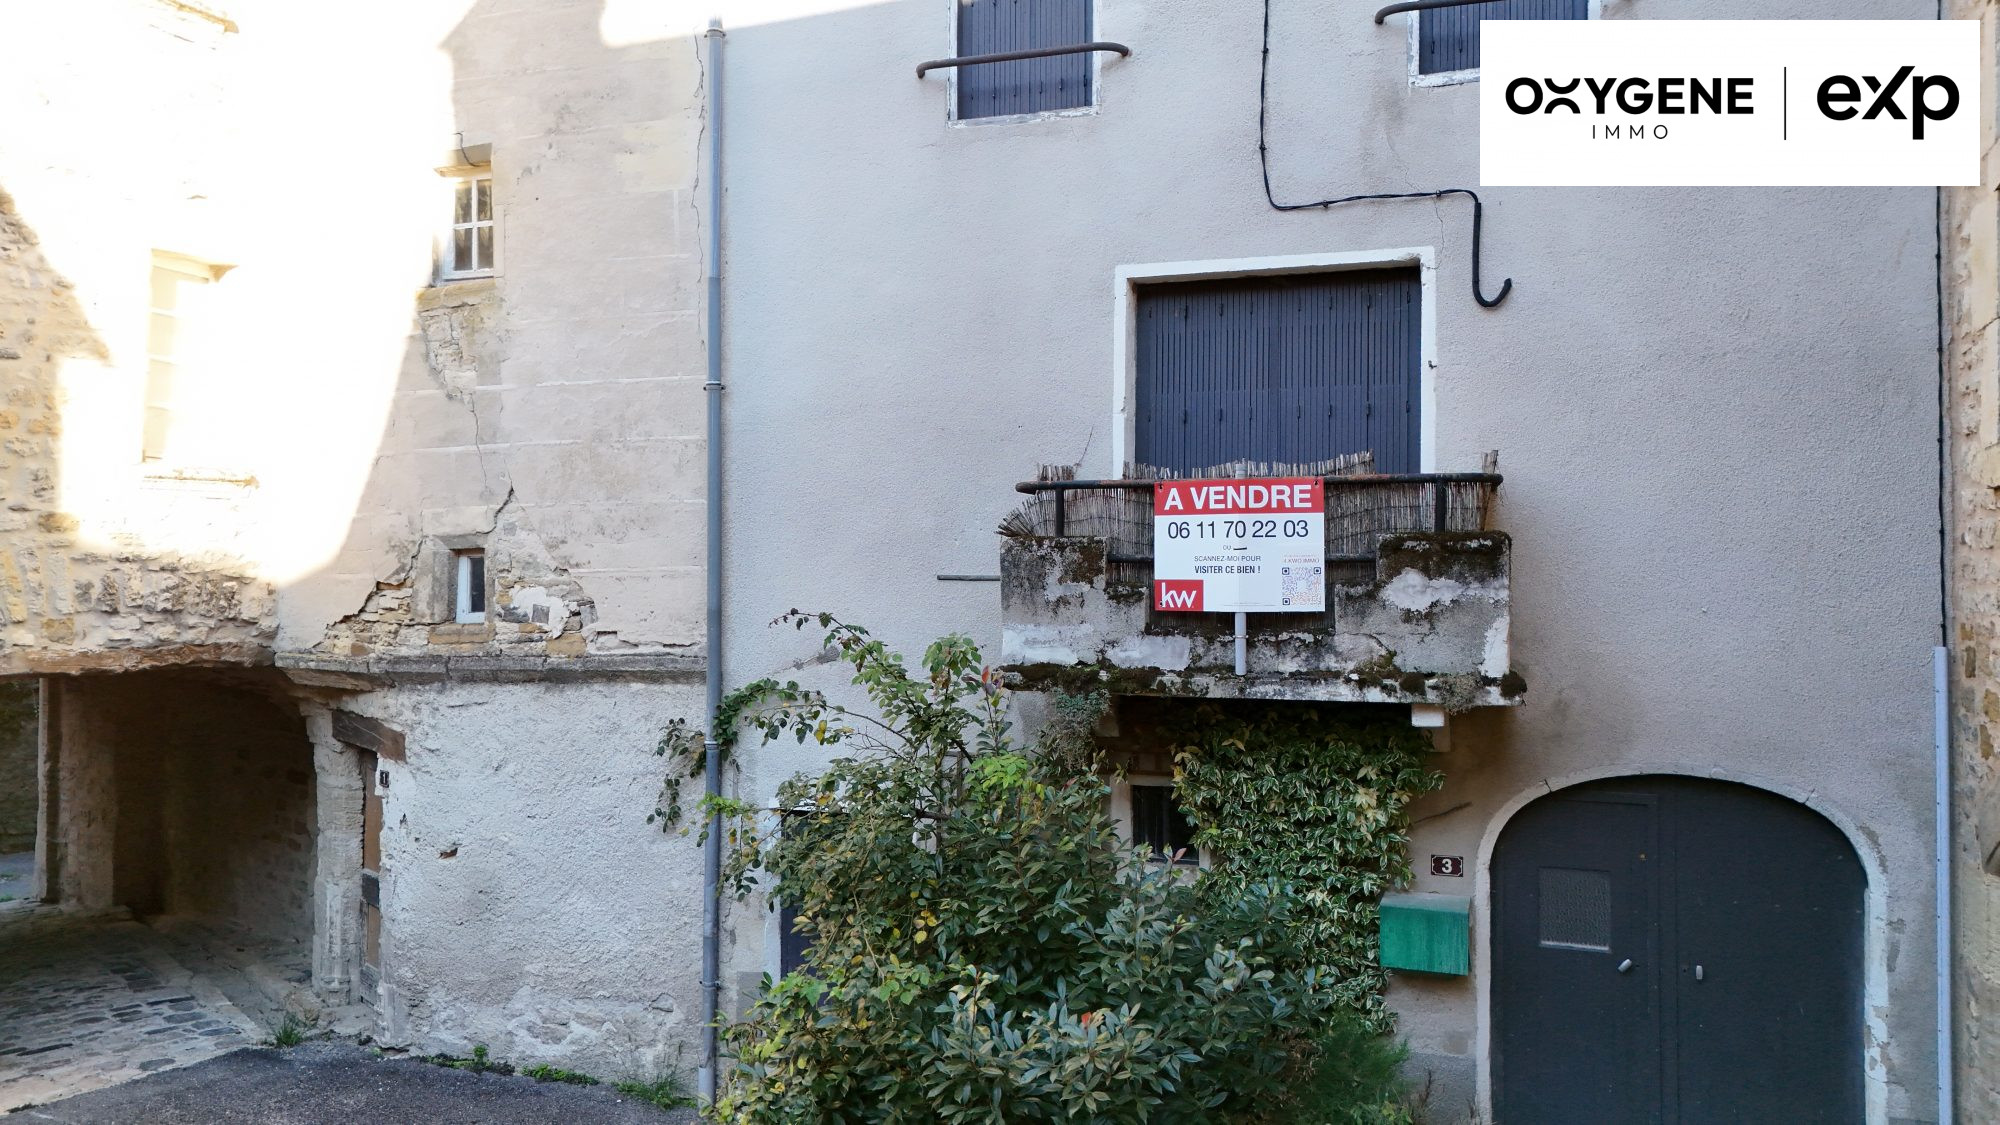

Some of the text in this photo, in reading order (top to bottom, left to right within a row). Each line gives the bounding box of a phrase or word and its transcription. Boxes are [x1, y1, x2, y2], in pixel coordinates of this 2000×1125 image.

[1164, 485, 1312, 511] A VENDRE
[1168, 520, 1309, 539] 06 11 70 22 03
[1194, 565, 1223, 574] VISITER
[1225, 565, 1235, 574] CE
[1236, 565, 1256, 574] BIEN
[1161, 582, 1197, 608] kw
[1441, 858, 1453, 874] 3
